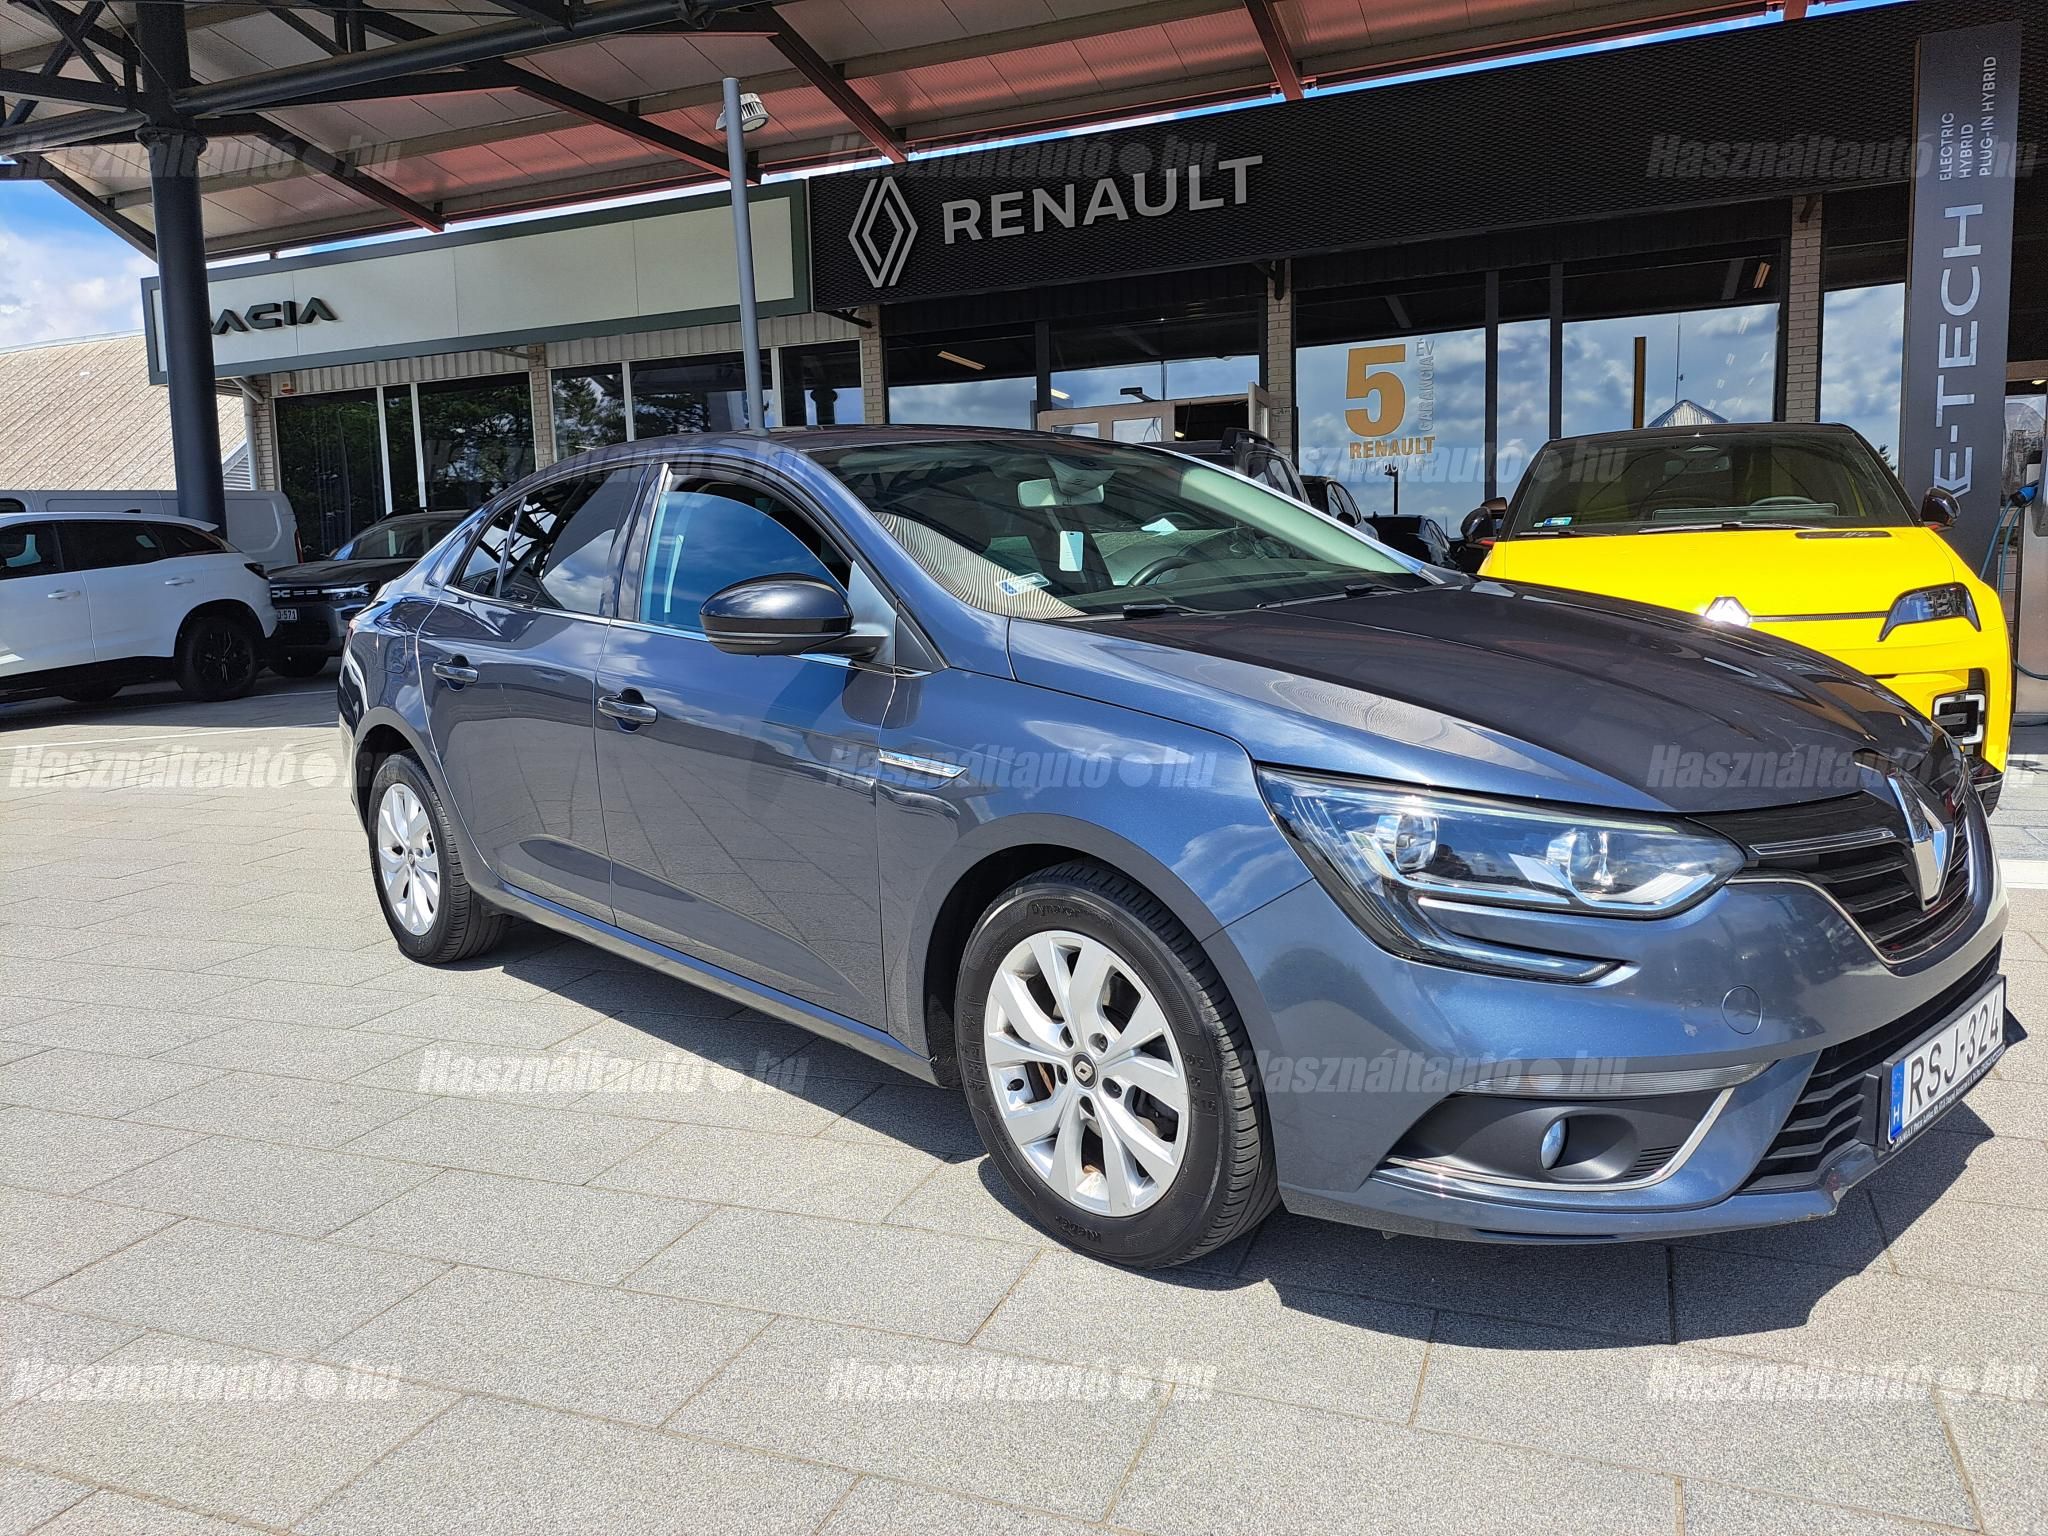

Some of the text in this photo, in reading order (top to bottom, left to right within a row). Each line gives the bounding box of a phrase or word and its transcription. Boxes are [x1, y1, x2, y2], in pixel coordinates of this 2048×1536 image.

[1940, 112, 1954, 181] ELECTRIC
[1979, 56, 1997, 176] PLUG-IN HYBRID
[1959, 123, 1974, 179] HYBRID
[941, 155, 1263, 245] RENAULT
[210, 296, 339, 336] ACIA
[1344, 343, 1406, 437] 5
[1349, 436, 1436, 460] RENAULT
[1908, 991, 1999, 1116] RSJ-324
[1893, 1104, 1900, 1126] H
